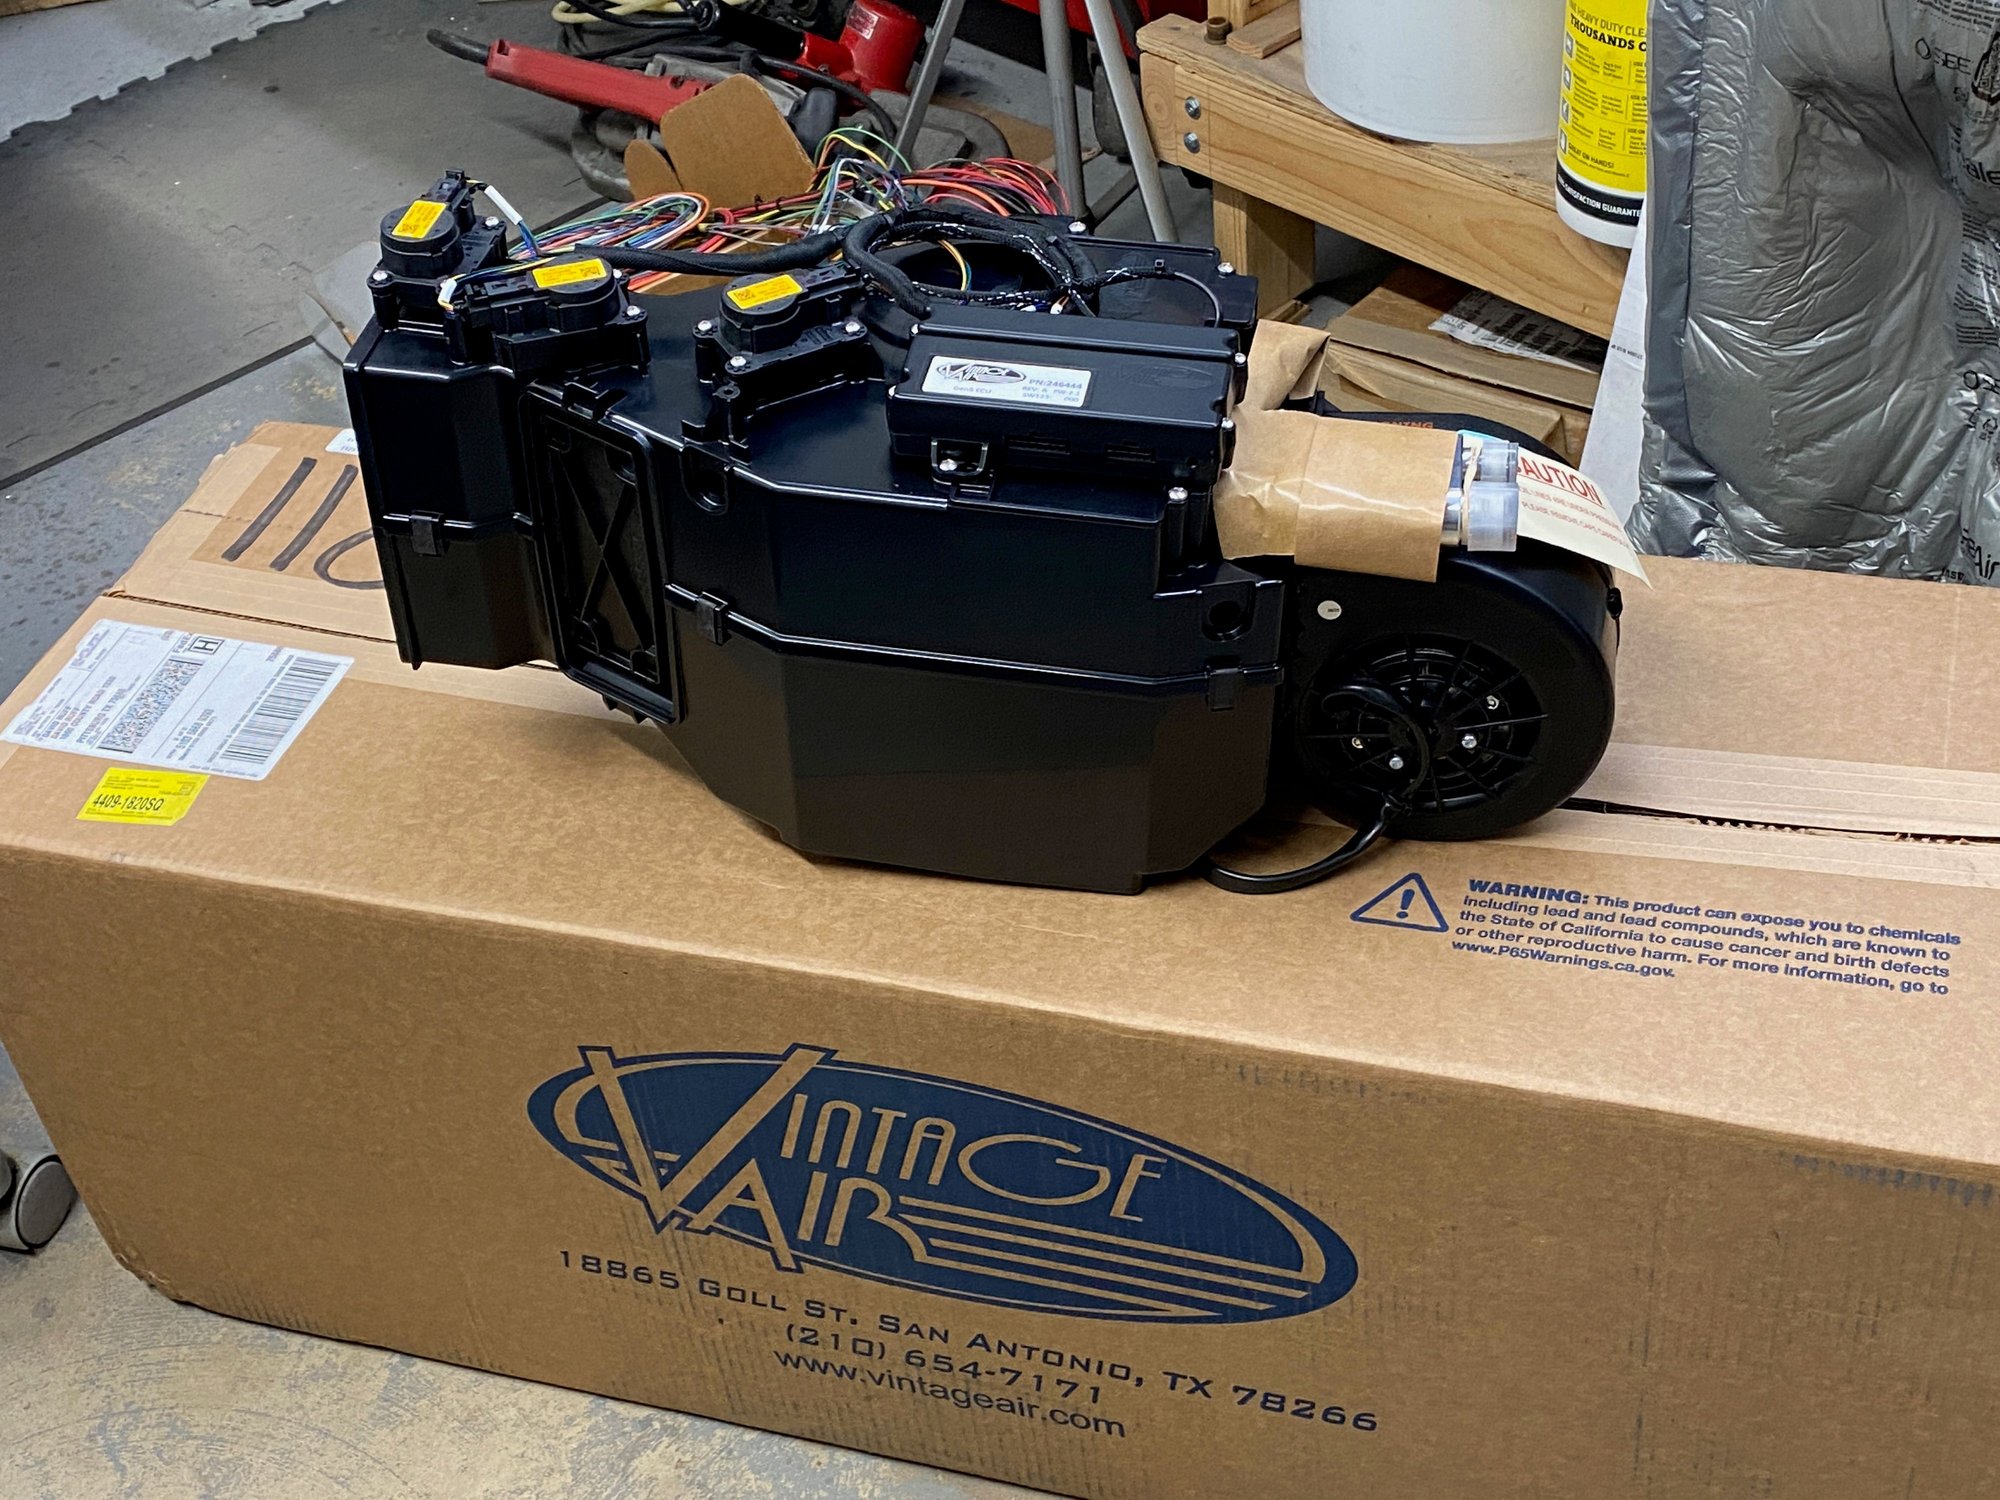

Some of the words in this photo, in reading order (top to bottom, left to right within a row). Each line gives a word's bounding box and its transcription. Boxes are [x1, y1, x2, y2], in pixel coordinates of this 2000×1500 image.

[1570, 13, 1635, 50] THOUSANDS
[1600, 18, 1623, 34] DUTY
[1625, 26, 1647, 37] CLE
[1517, 456, 1603, 505] AUTION
[1459, 909, 1486, 923] the
[1490, 914, 1535, 929] State
[1539, 919, 1558, 931] of
[1561, 922, 1643, 942] California
[1648, 932, 1667, 945] to
[1671, 937, 1723, 951] cause
[1728, 941, 1790, 959] cancer
[1794, 949, 1829, 964] and
[1833, 952, 1876, 969] birth
[1881, 959, 1950, 978] defects
[1463, 895, 1538, 916] including
[1544, 903, 1578, 919] lead
[1582, 908, 1616, 924] and
[1621, 911, 1656, 927] lead
[1661, 920, 1769, 942] compounds,
[1774, 930, 1827, 947] which
[1831, 938, 1862, 951] are
[1866, 941, 1926, 959] known
[1931, 947, 1951, 961] to
[1469, 879, 1589, 904] WARNING:
[1594, 895, 1629, 909] This
[1633, 899, 1701, 917] product
[1705, 907, 1737, 920] can
[1740, 911, 1805, 928] expose
[1808, 917, 1842, 933] you
[1846, 922, 1865, 935] to
[1868, 925, 1961, 945] chemicals
[1451, 939, 1675, 978] www.P65Warnings.ca.gov.
[1455, 924, 1474, 937] or
[1478, 928, 1524, 945] other
[1527, 935, 1637, 957] reproductive
[1642, 947, 1693, 964] harm.
[1697, 953, 1729, 967] For
[1732, 959, 1779, 974] more
[1783, 963, 1896, 990] information,
[1900, 979, 1924, 994] go
[1929, 981, 1950, 995] to
[580, 1045, 1168, 1232] VINTAGE
[686, 1157, 930, 1270] AIR
[559, 1250, 680, 1290] 18865
[699, 1278, 788, 1312] GOLL
[804, 1299, 858, 1325] ST.
[878, 1314, 949, 1344] SAN
[967, 1333, 1143, 1387] ANTONIO,
[1163, 1371, 1214, 1399] TX
[1232, 1385, 1378, 1432] 78266
[786, 1323, 886, 1360] (210)
[904, 1350, 1101, 1403] 654-7171
[773, 1350, 1126, 1438] www.vintageair.com
